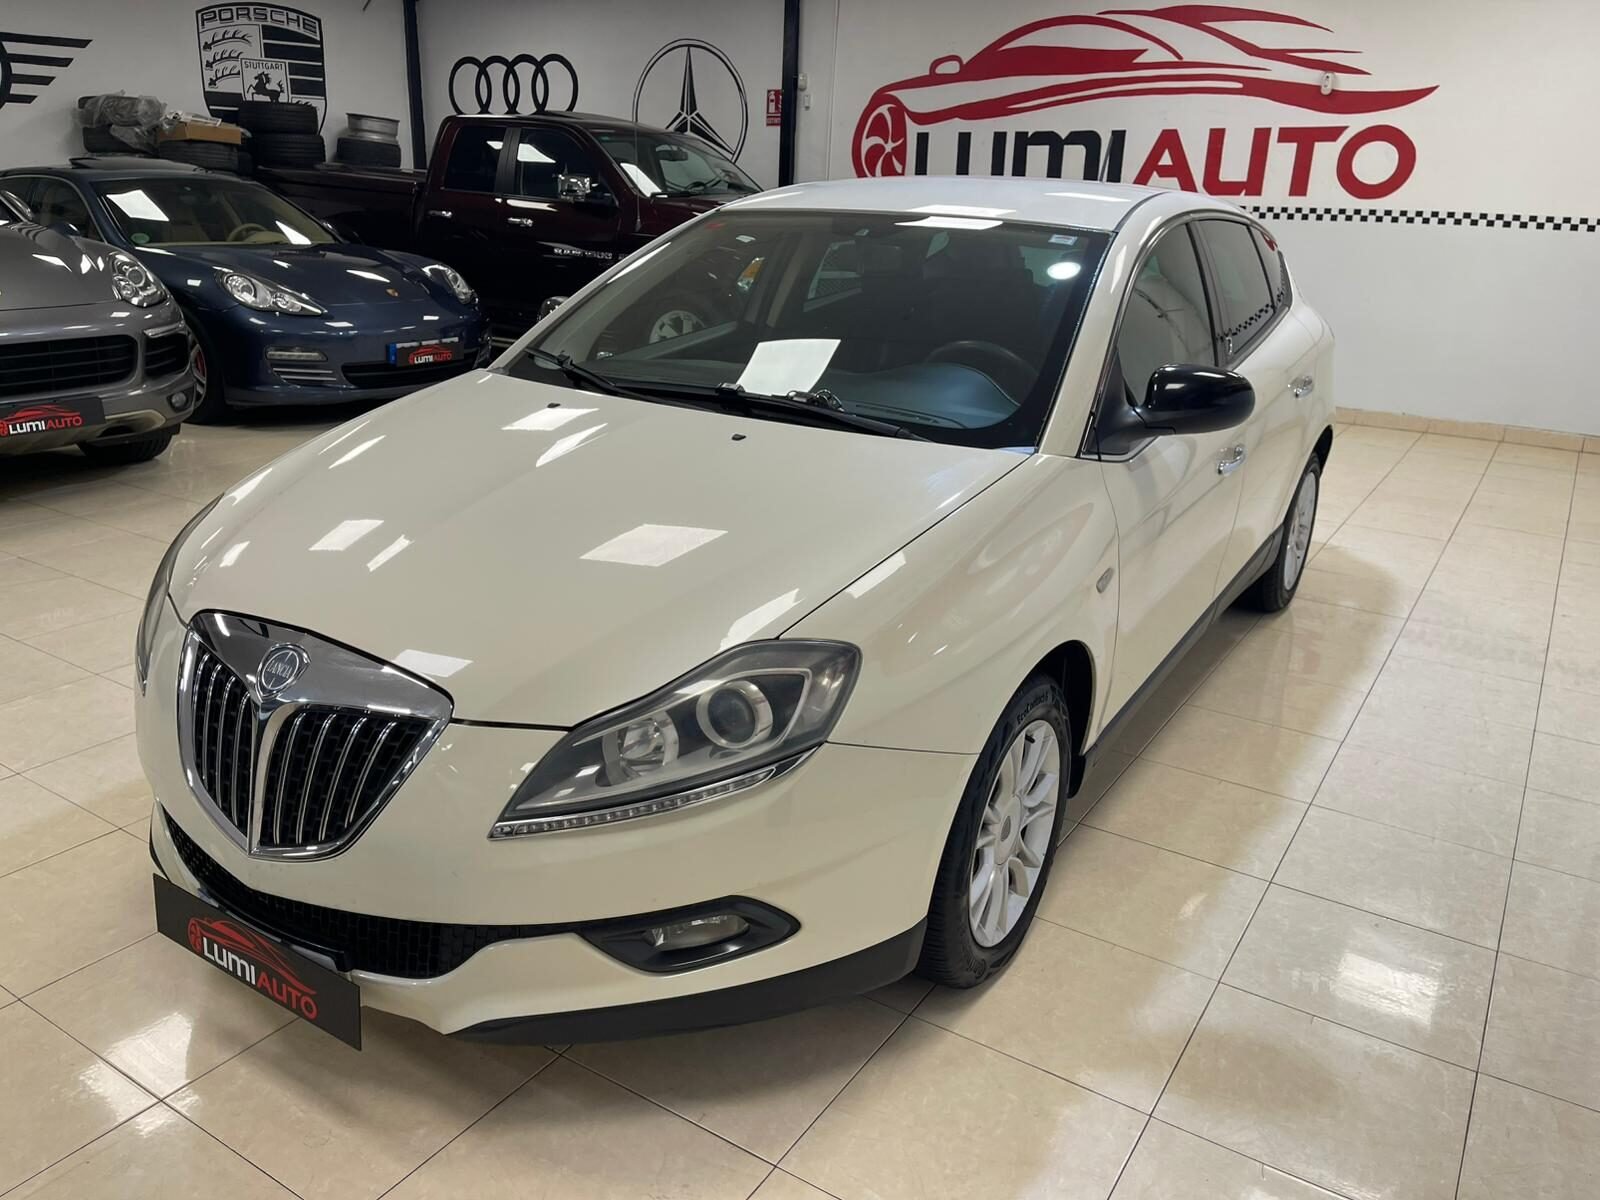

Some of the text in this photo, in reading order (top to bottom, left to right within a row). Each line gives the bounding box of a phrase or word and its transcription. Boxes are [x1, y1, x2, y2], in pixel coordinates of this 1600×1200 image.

[200, 6, 319, 39] PORSCHE
[244, 60, 284, 72] STUTTGART
[265, 659, 294, 679] LANCIA
